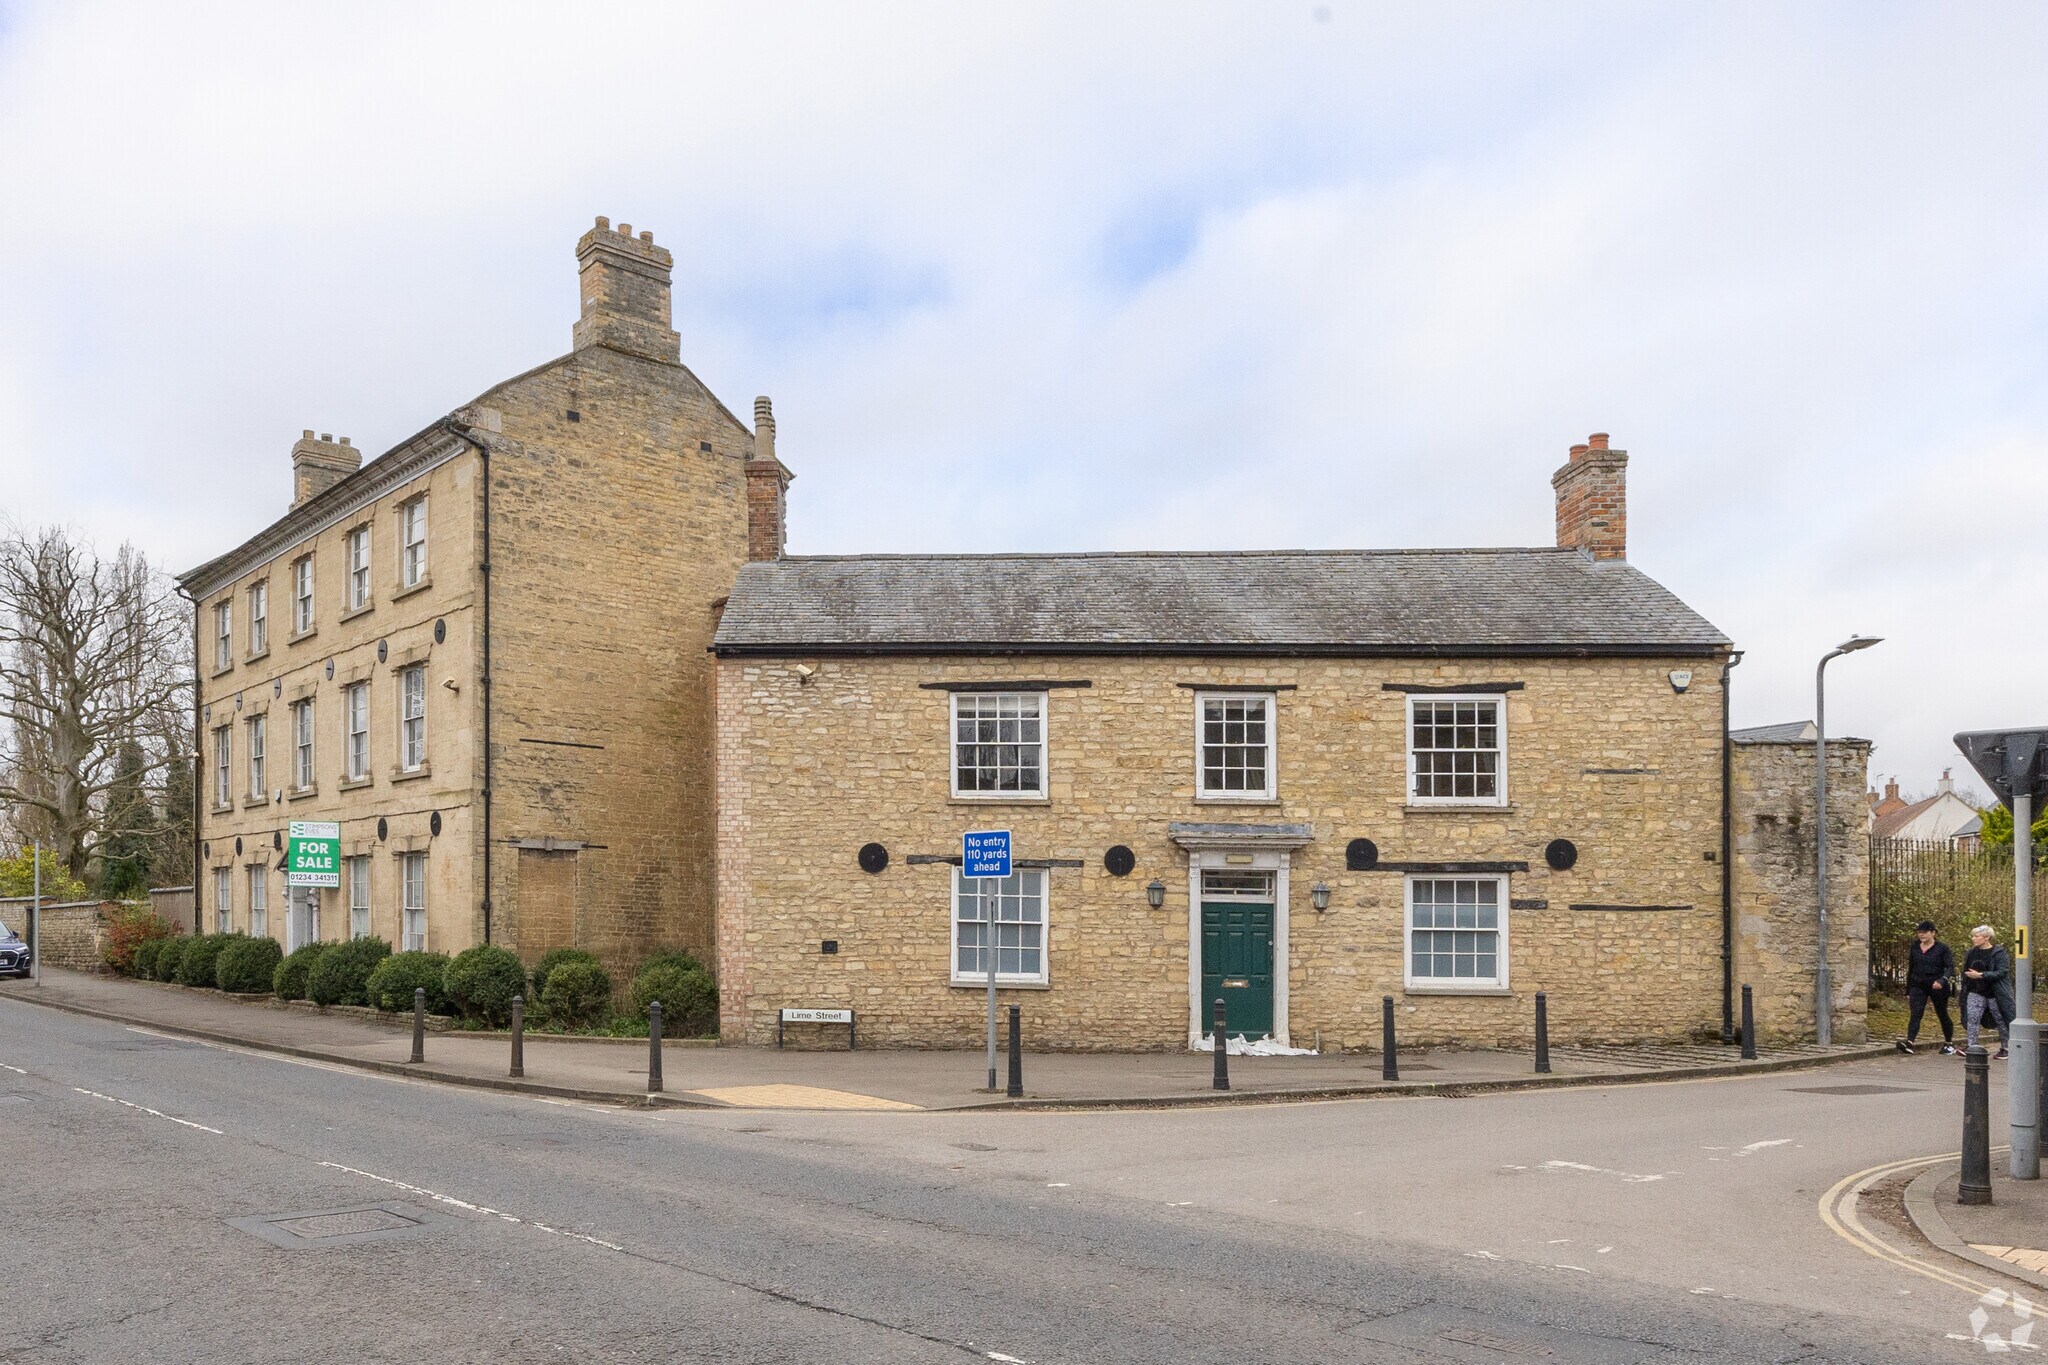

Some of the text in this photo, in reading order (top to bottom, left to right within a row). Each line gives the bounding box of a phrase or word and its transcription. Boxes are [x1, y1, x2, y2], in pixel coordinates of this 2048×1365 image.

[299, 842, 329, 854] FOR
[968, 836, 1006, 848] No entry
[967, 848, 1007, 861] 110 yards
[296, 856, 332, 869] SALE
[973, 861, 1000, 872] ahead
[815, 1011, 842, 1020] Street
